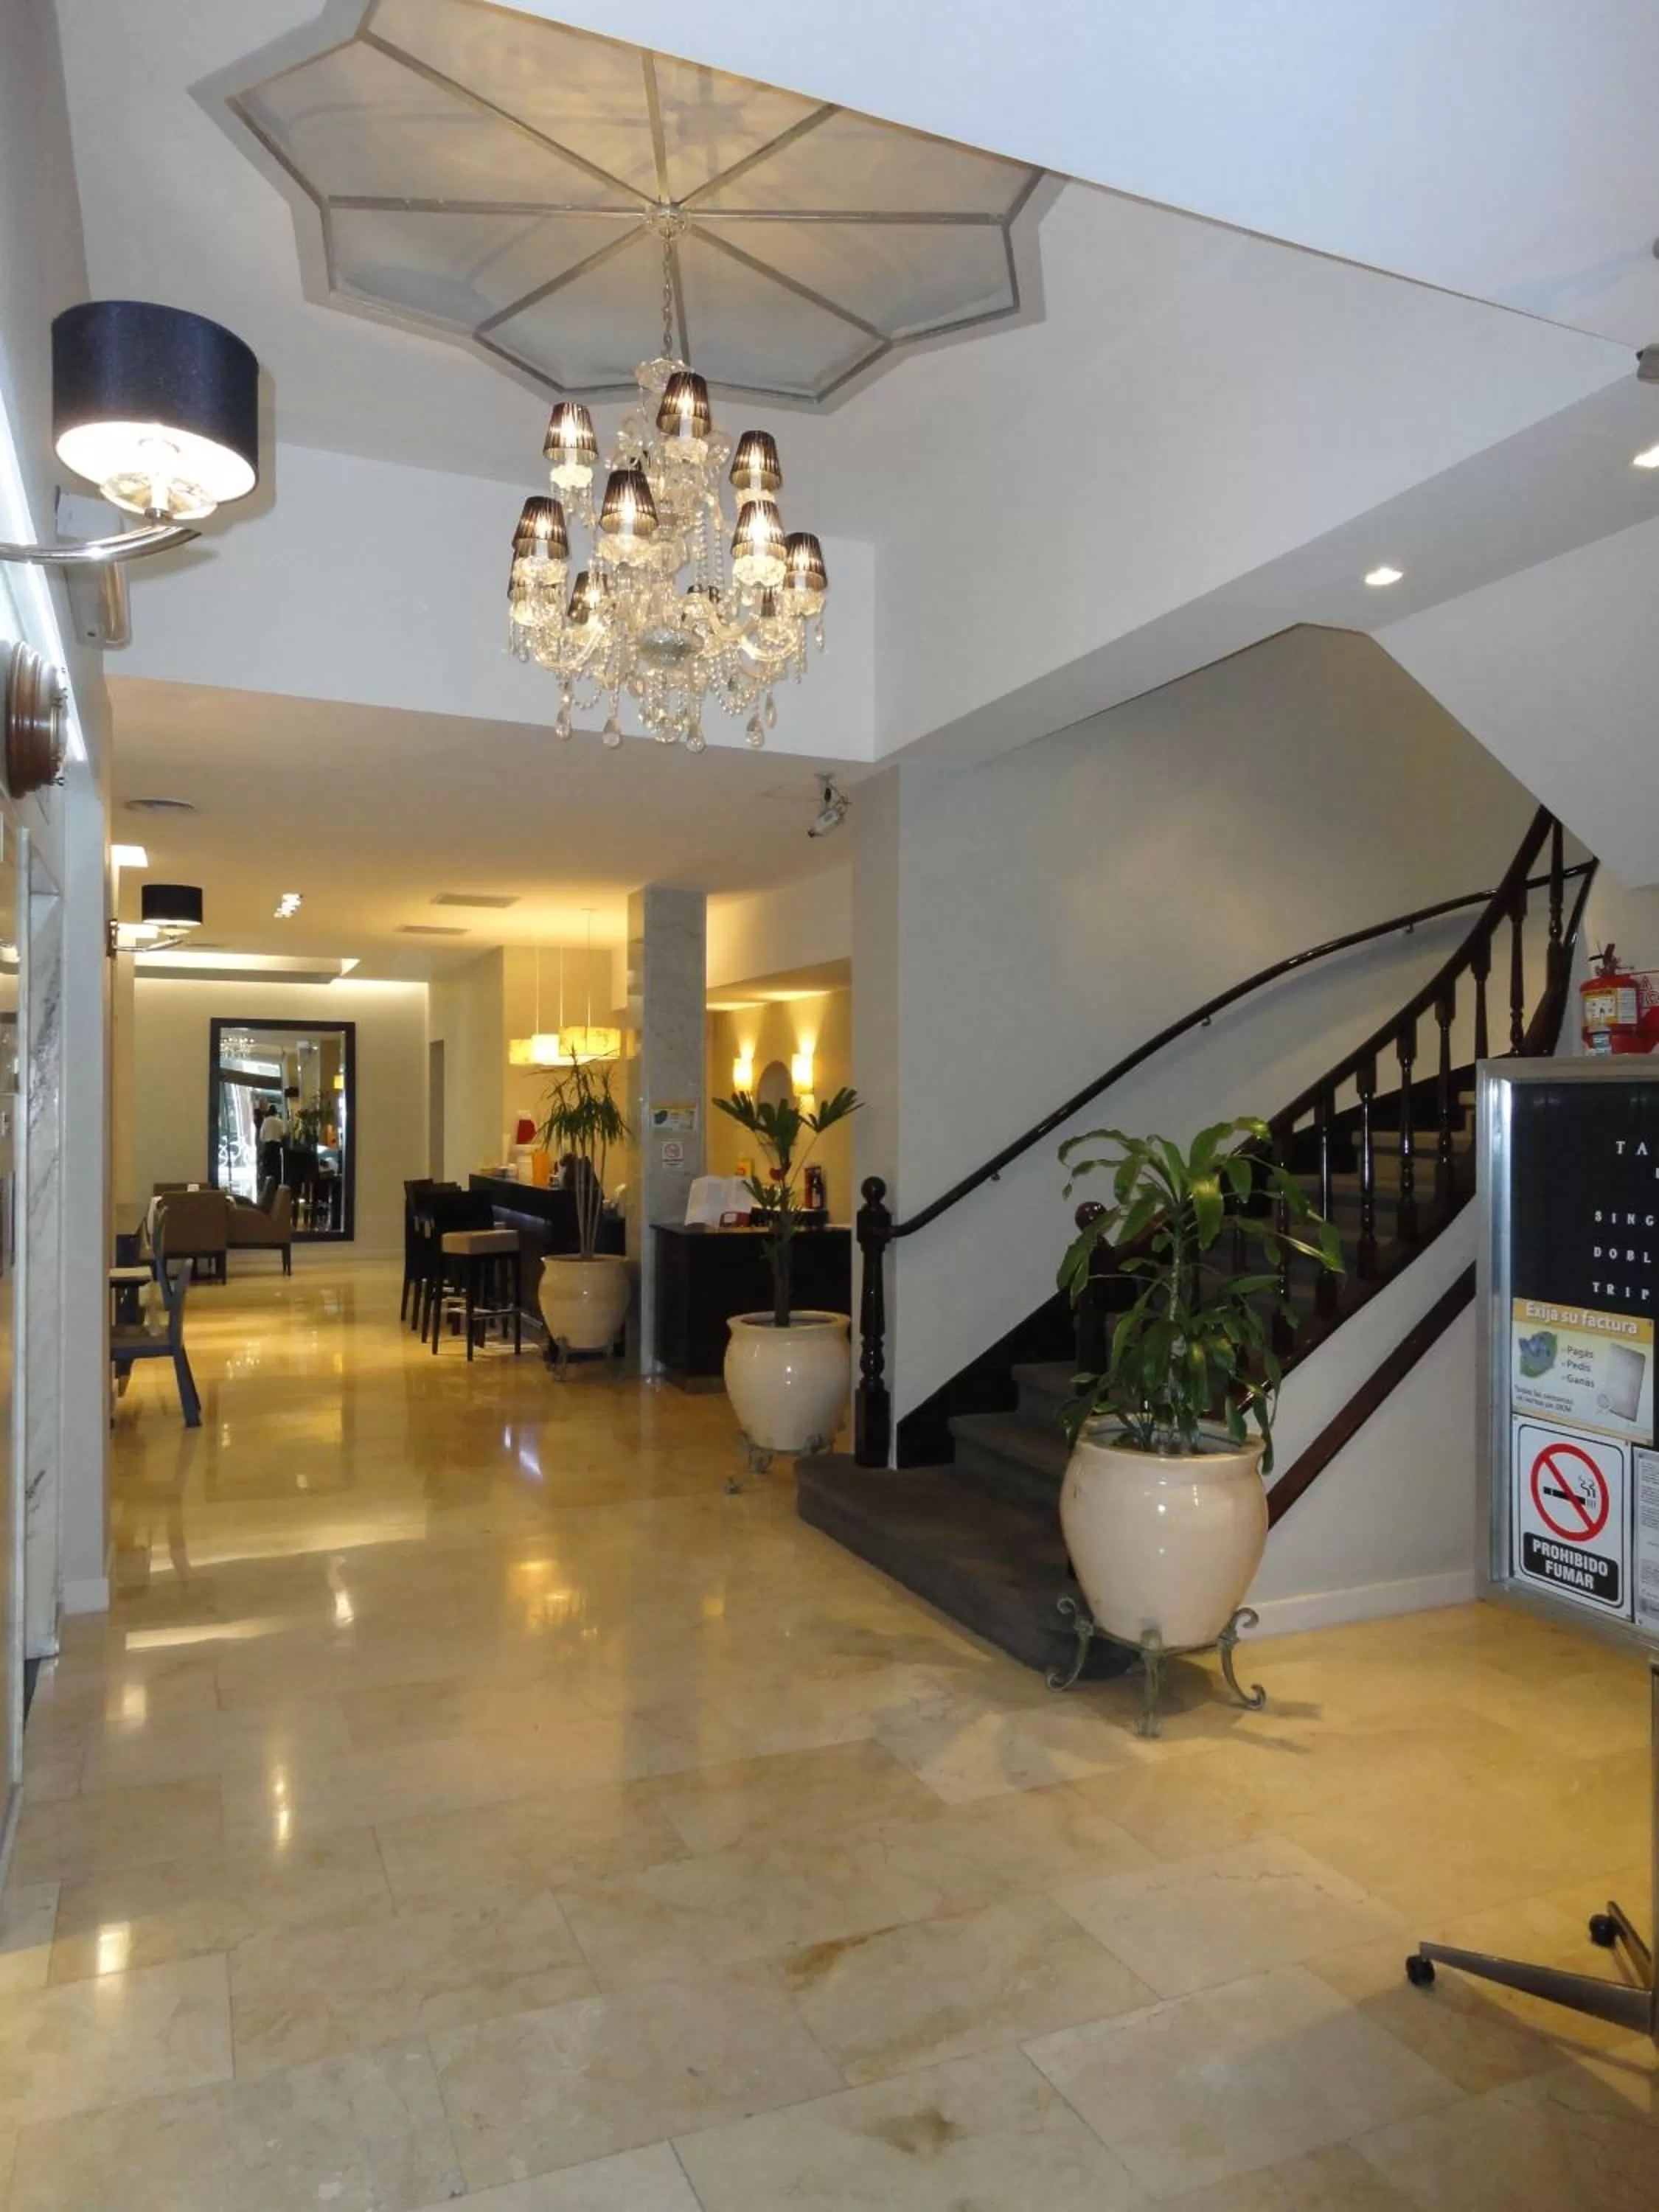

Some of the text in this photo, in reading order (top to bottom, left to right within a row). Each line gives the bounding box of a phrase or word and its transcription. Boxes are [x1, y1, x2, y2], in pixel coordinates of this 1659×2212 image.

[1615, 1140, 1649, 1155] TA
[1594, 1210, 1655, 1226] SING
[1593, 1245, 1652, 1263] DOBL
[1592, 1281, 1650, 1300] TRIP
[1526, 1301, 1638, 1335] Exija su factura
[1533, 1538, 1608, 1576] PROHIBIDO
[1545, 1559, 1593, 1589] FUMAR
